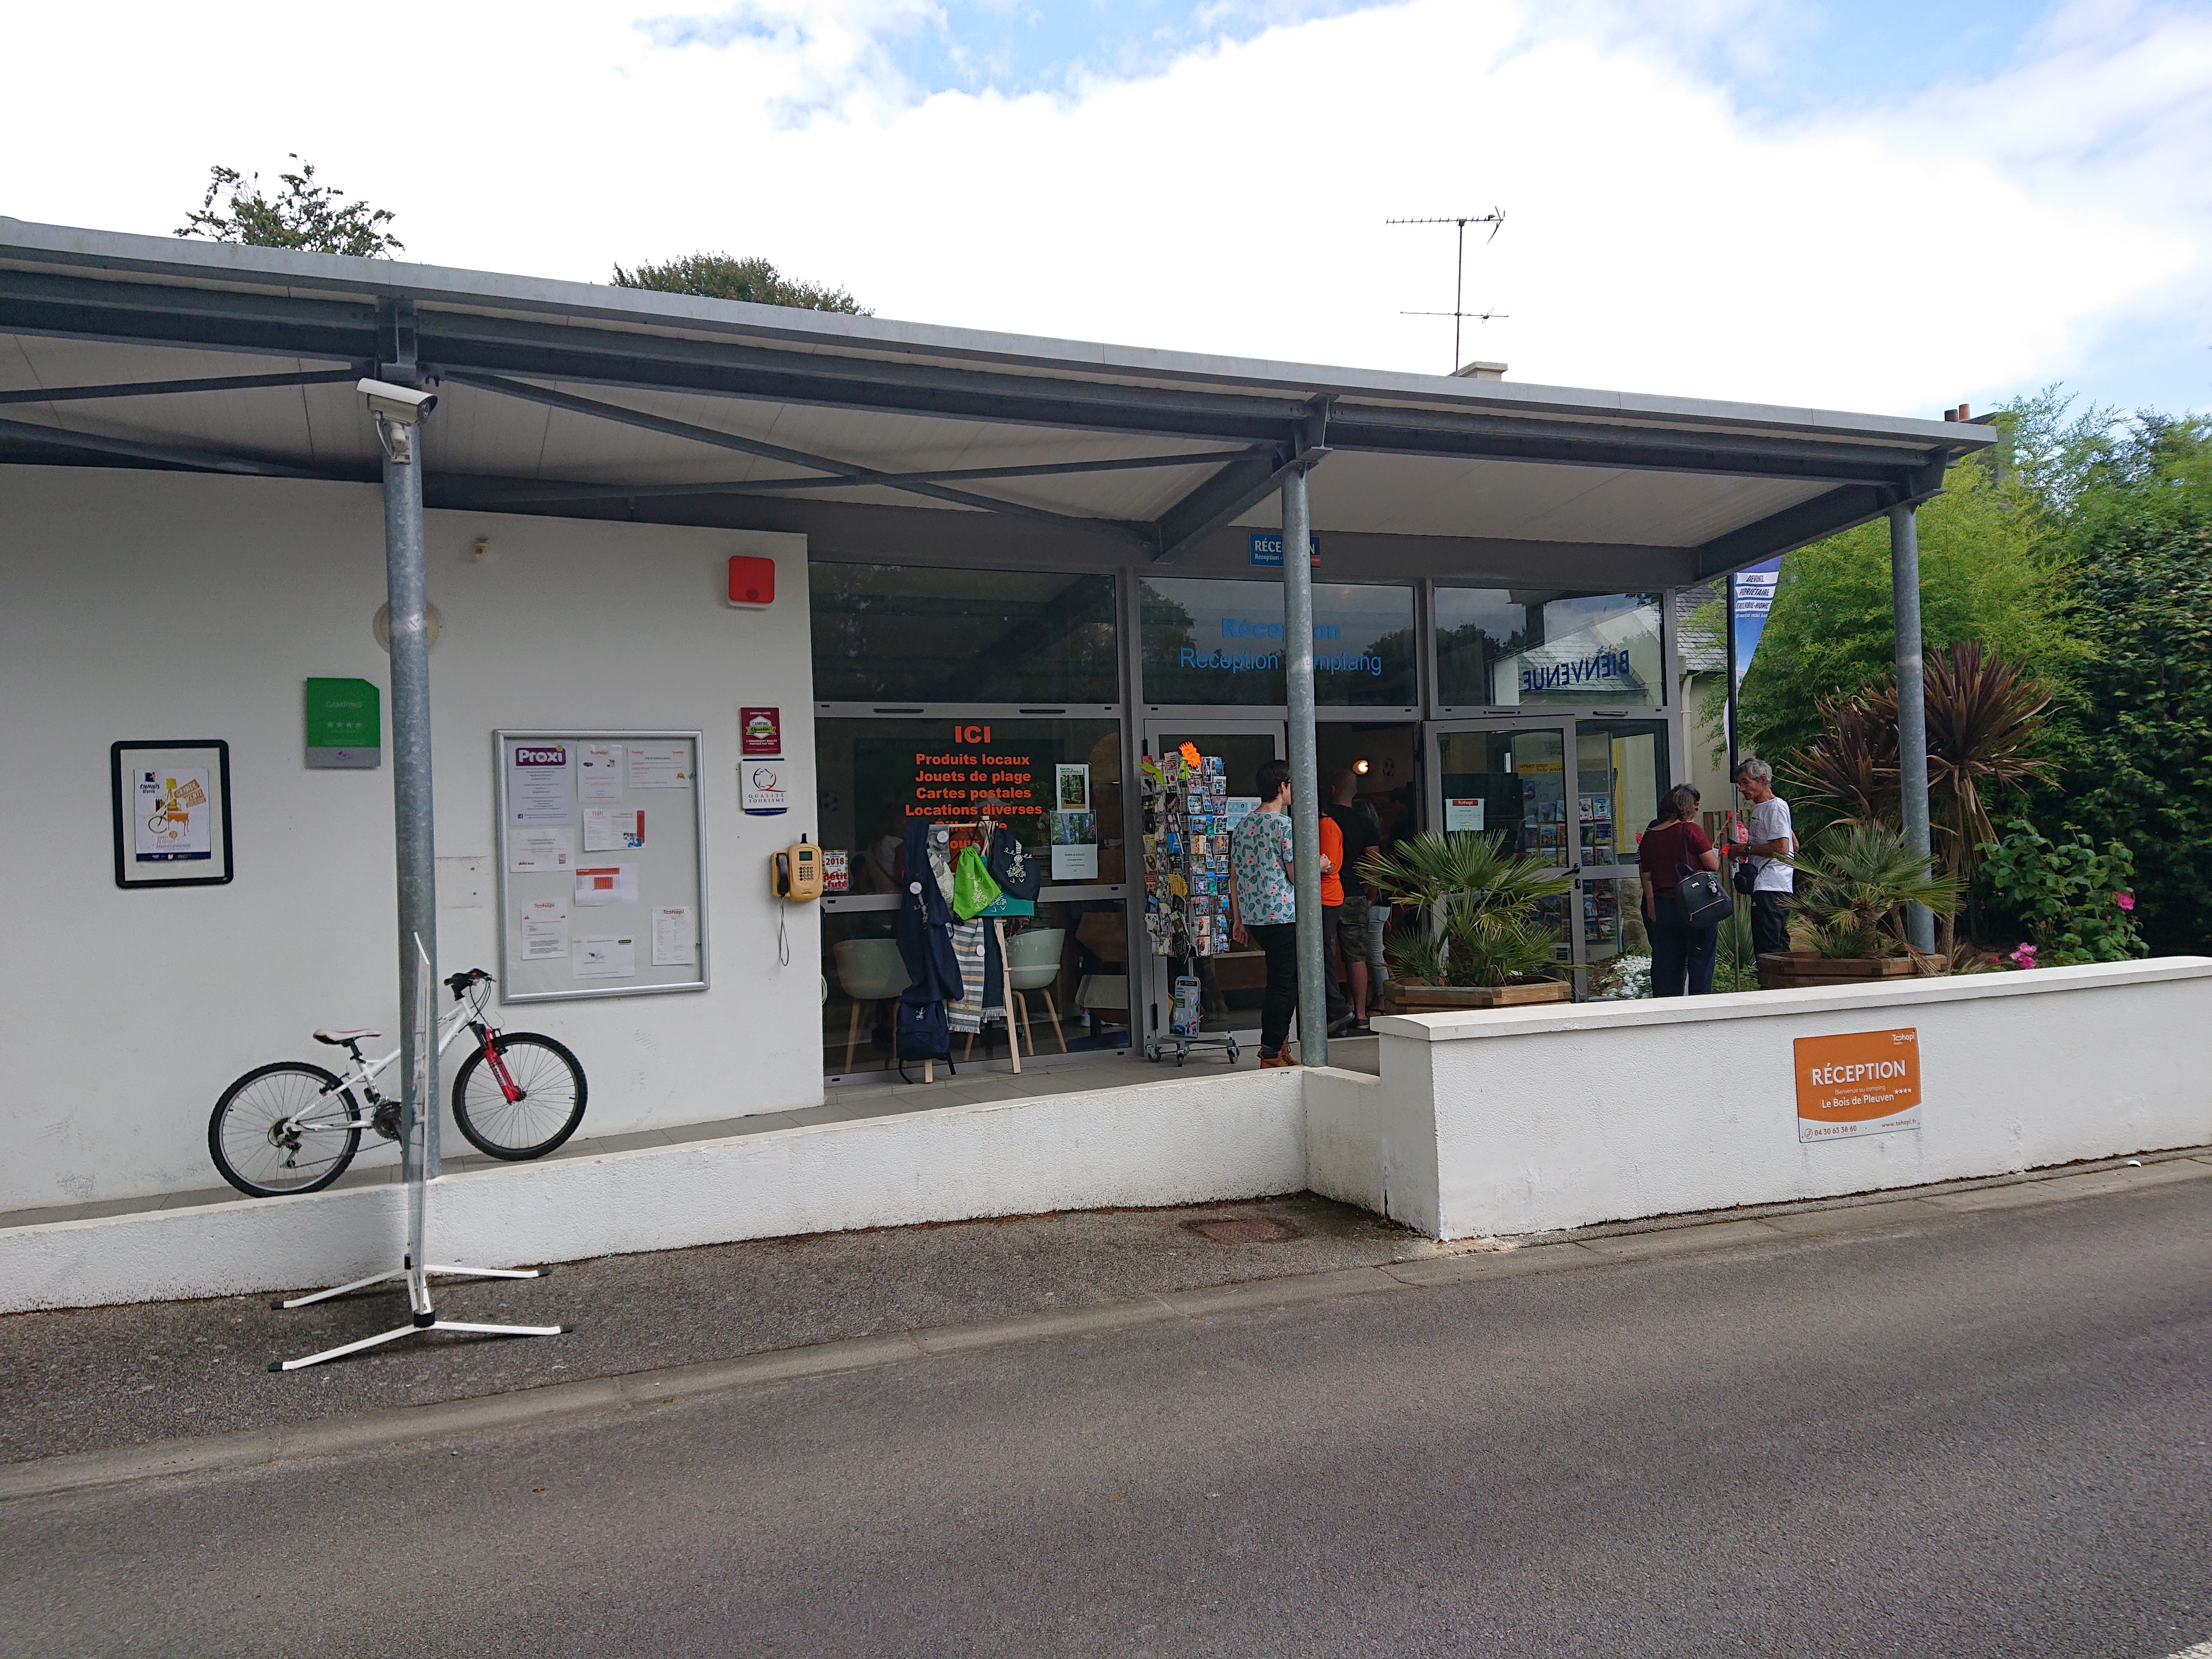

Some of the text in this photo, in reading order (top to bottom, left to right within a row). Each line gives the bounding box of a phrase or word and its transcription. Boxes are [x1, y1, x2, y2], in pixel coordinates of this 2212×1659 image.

[1255, 538, 1315, 555] RÉCEN
[1222, 617, 1341, 644] Réceon
[1313, 651, 1382, 676] mpfang
[955, 726, 991, 743] ICI
[518, 748, 563, 763] Proxi
[916, 753, 1030, 765] Produits locaux
[915, 770, 1031, 784] Jouets de plage
[916, 788, 1031, 801] Cartes postales
[905, 804, 1043, 816] Locations diverses
[1892, 1033, 1915, 1042] Tohapi
[1812, 1060, 1906, 1085] RÉCEPTION
[1822, 1094, 1894, 1109] Le Bois de Pleuven
[1882, 1118, 1917, 1128] www.tohapi.fr
